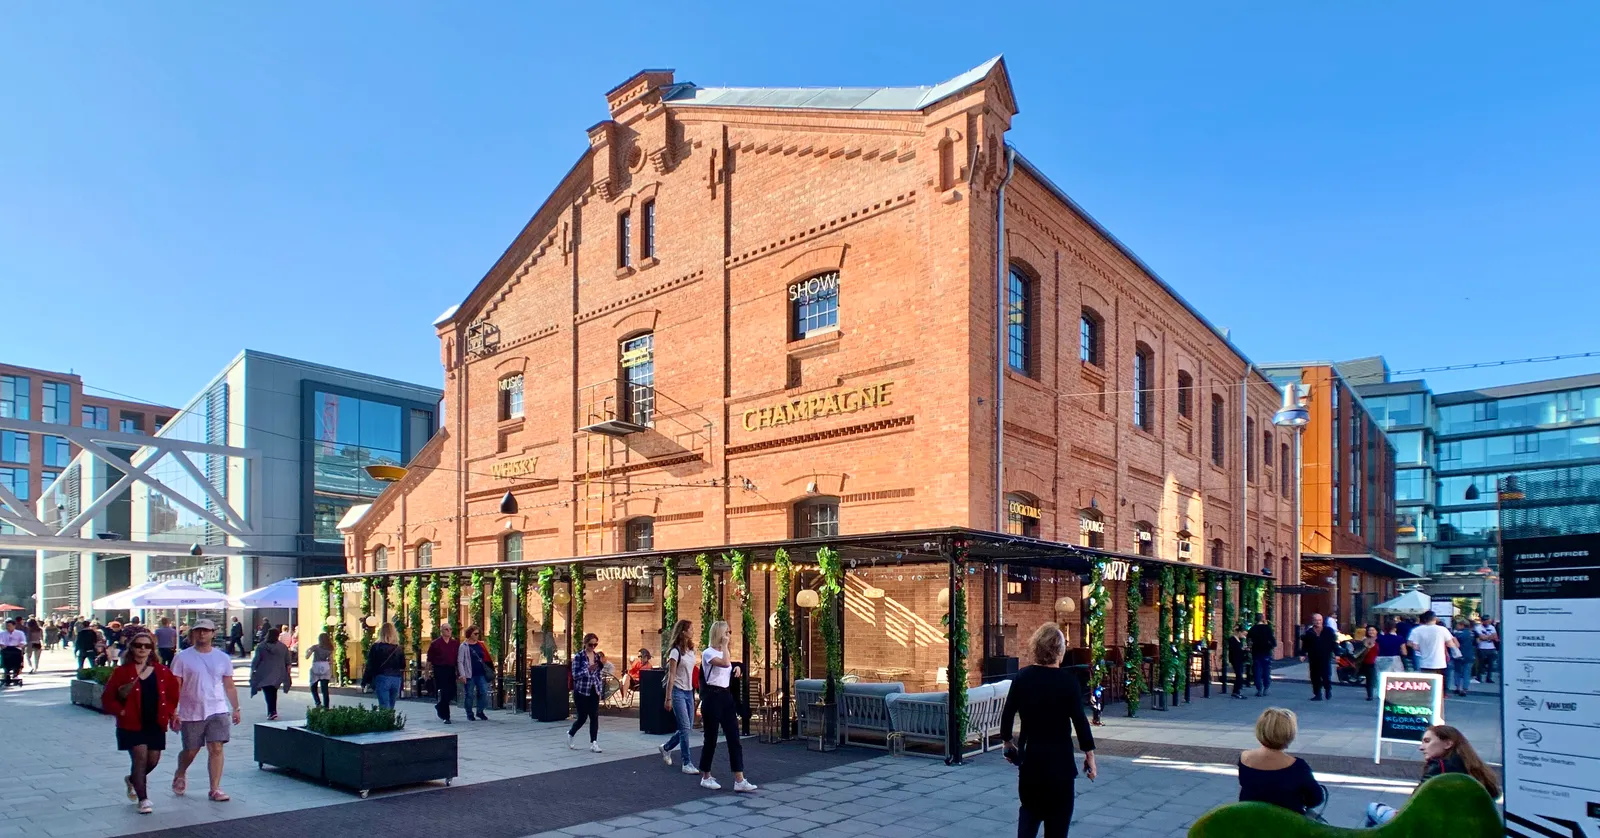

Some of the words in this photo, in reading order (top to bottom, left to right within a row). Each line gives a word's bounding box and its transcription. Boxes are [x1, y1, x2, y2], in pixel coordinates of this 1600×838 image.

[788, 272, 837, 302] SHOW
[498, 374, 523, 392] MUSIC
[742, 381, 895, 431] CHAMPAGNE
[490, 457, 538, 480] WHISKY
[1009, 502, 1042, 519] COCKTAILS
[1081, 518, 1105, 534] LOUNGE
[595, 565, 649, 581] ENTRANCE
[1395, 681, 1431, 691] KAWA
